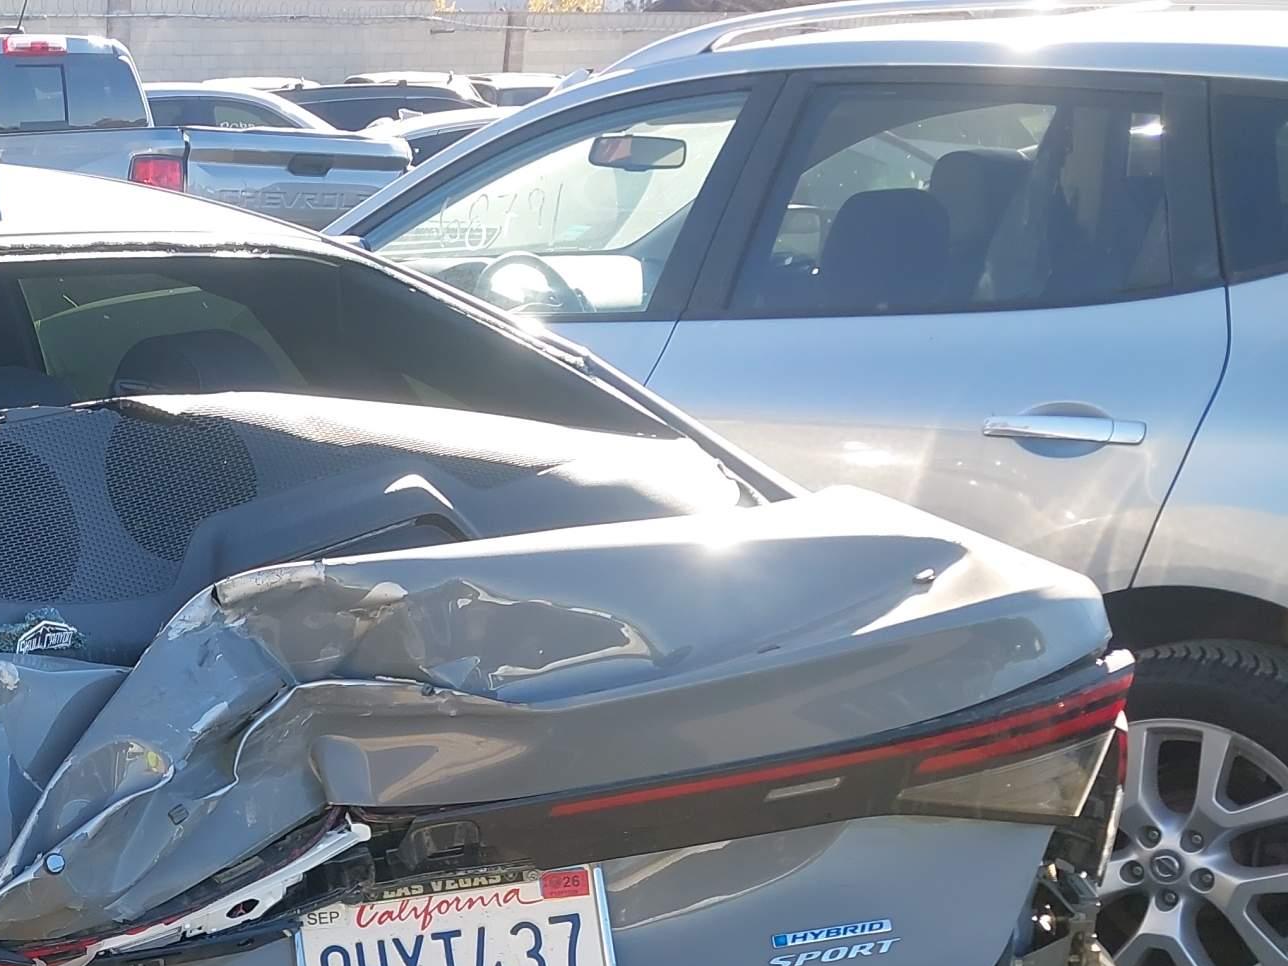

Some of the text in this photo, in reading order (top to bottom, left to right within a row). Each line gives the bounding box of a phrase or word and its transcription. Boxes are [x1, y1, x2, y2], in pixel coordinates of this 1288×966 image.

[562, 875, 580, 888] 26
[355, 886, 545, 931] California
[307, 911, 340, 925] SEP
[790, 921, 885, 944] HYBRID
